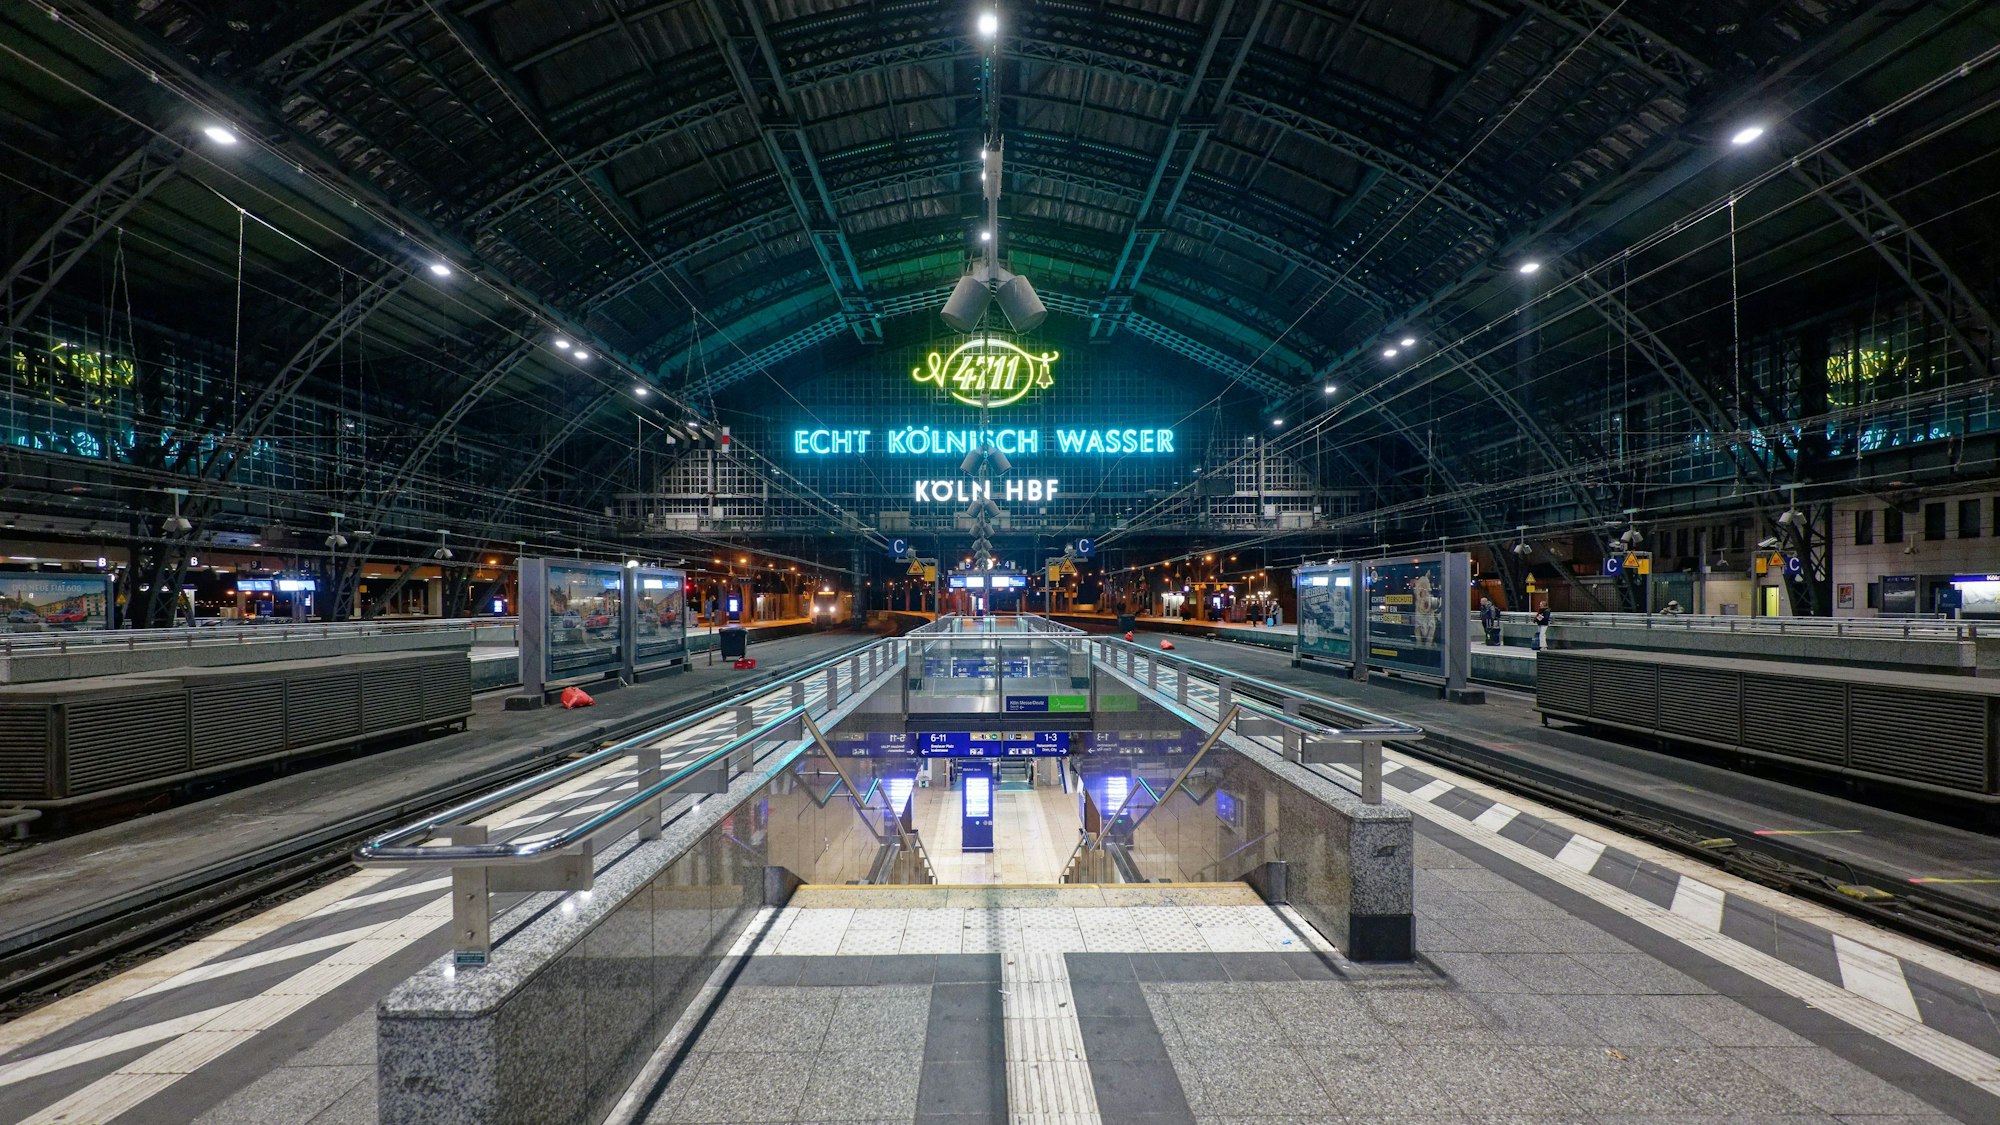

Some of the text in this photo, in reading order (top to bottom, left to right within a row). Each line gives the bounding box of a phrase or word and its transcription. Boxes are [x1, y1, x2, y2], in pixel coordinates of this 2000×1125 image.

[952, 355, 1020, 390] 4711
[795, 425, 1174, 454] ECHT KÖLNISCH WASSER
[915, 479, 1058, 502] KÖLN HBF
[893, 540, 905, 554] C
[1078, 539, 1090, 553] C
[98, 557, 107, 567] B
[190, 556, 198, 566] B
[1606, 558, 1617, 573] C
[1789, 557, 1800, 571] C
[29, 584, 49, 592] NEUE
[50, 584, 66, 592] FIAT
[67, 584, 82, 592] 600
[930, 733, 947, 742] 6-11
[1044, 733, 1058, 741] 1-3
